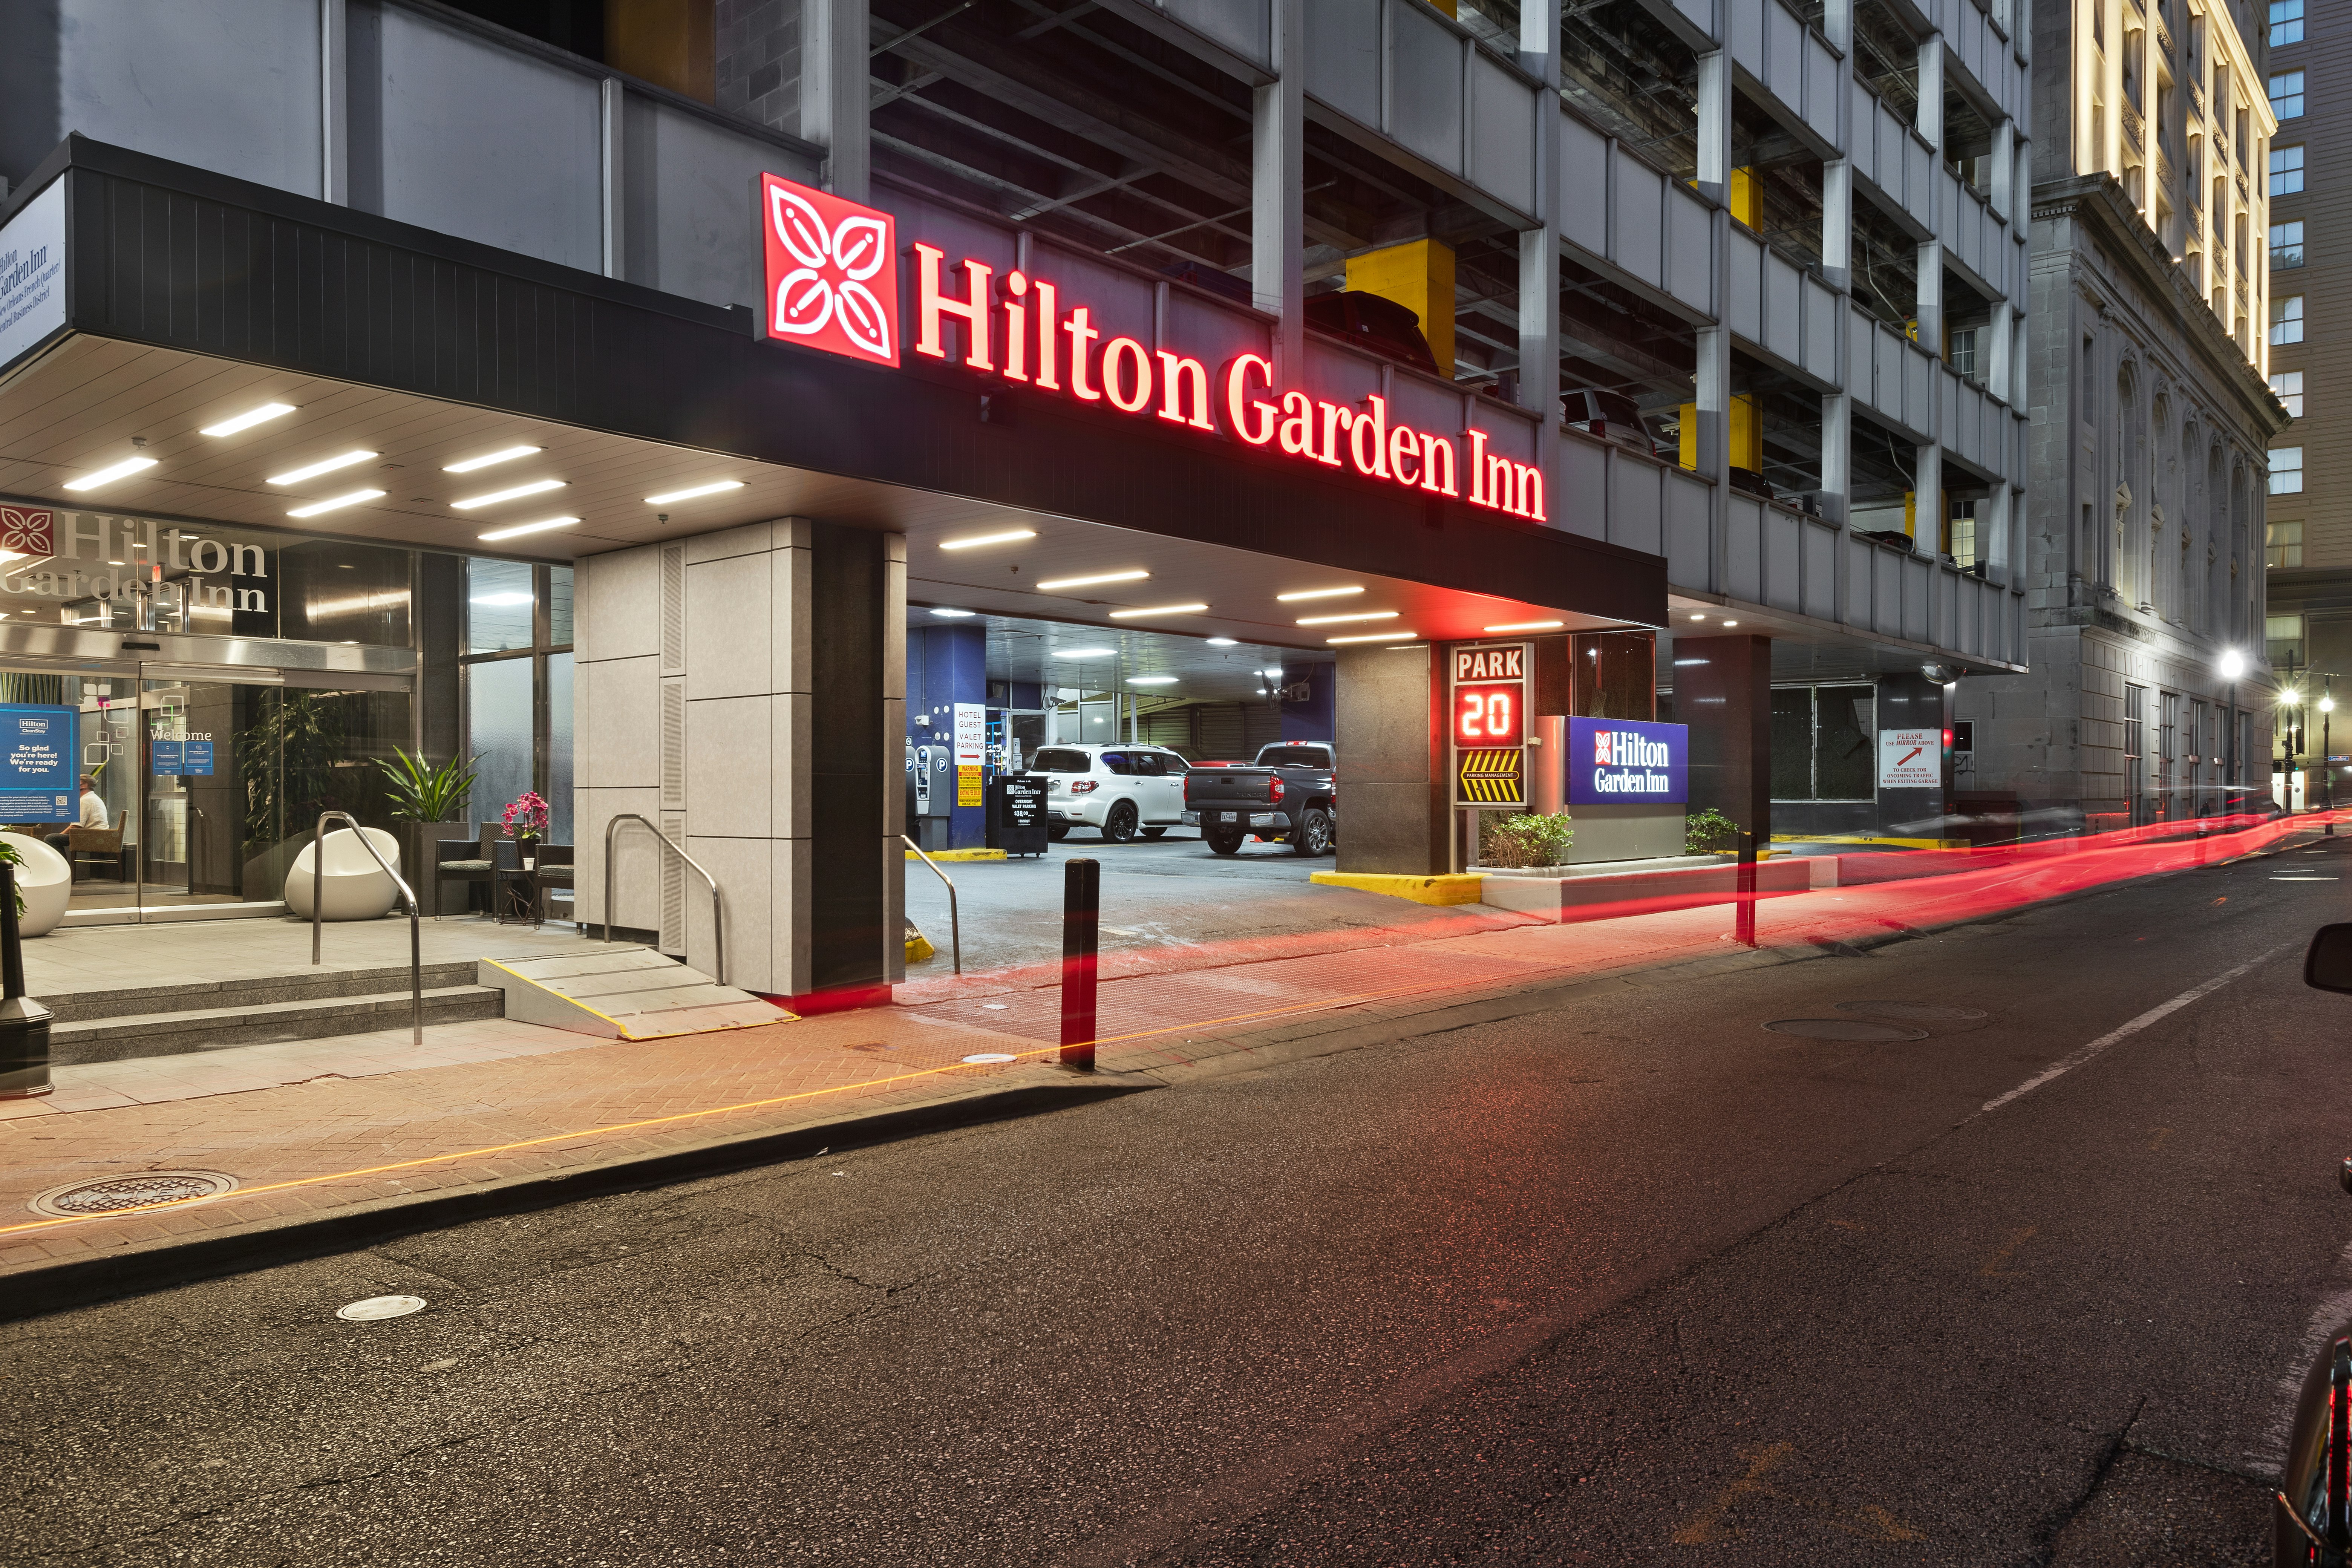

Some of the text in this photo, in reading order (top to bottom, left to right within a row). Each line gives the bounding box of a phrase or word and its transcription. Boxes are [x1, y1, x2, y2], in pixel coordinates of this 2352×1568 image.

[0, 285, 50, 333] entral Business District
[7, 291, 24, 311] Orleans
[24, 275, 40, 298] French
[914, 241, 1547, 522] Hilton Garden Inn
[61, 511, 268, 578] Hilton
[0, 559, 269, 613] Garden Inn
[1458, 650, 1522, 678] PARK
[1461, 693, 1511, 737] 20
[150, 729, 212, 741] Welcome
[1611, 730, 1669, 768] Hilton
[906, 760, 912, 769] P
[939, 760, 945, 770] P
[1594, 767, 1670, 793] Garden Inn
[66, 1187, 205, 1204] WATER
